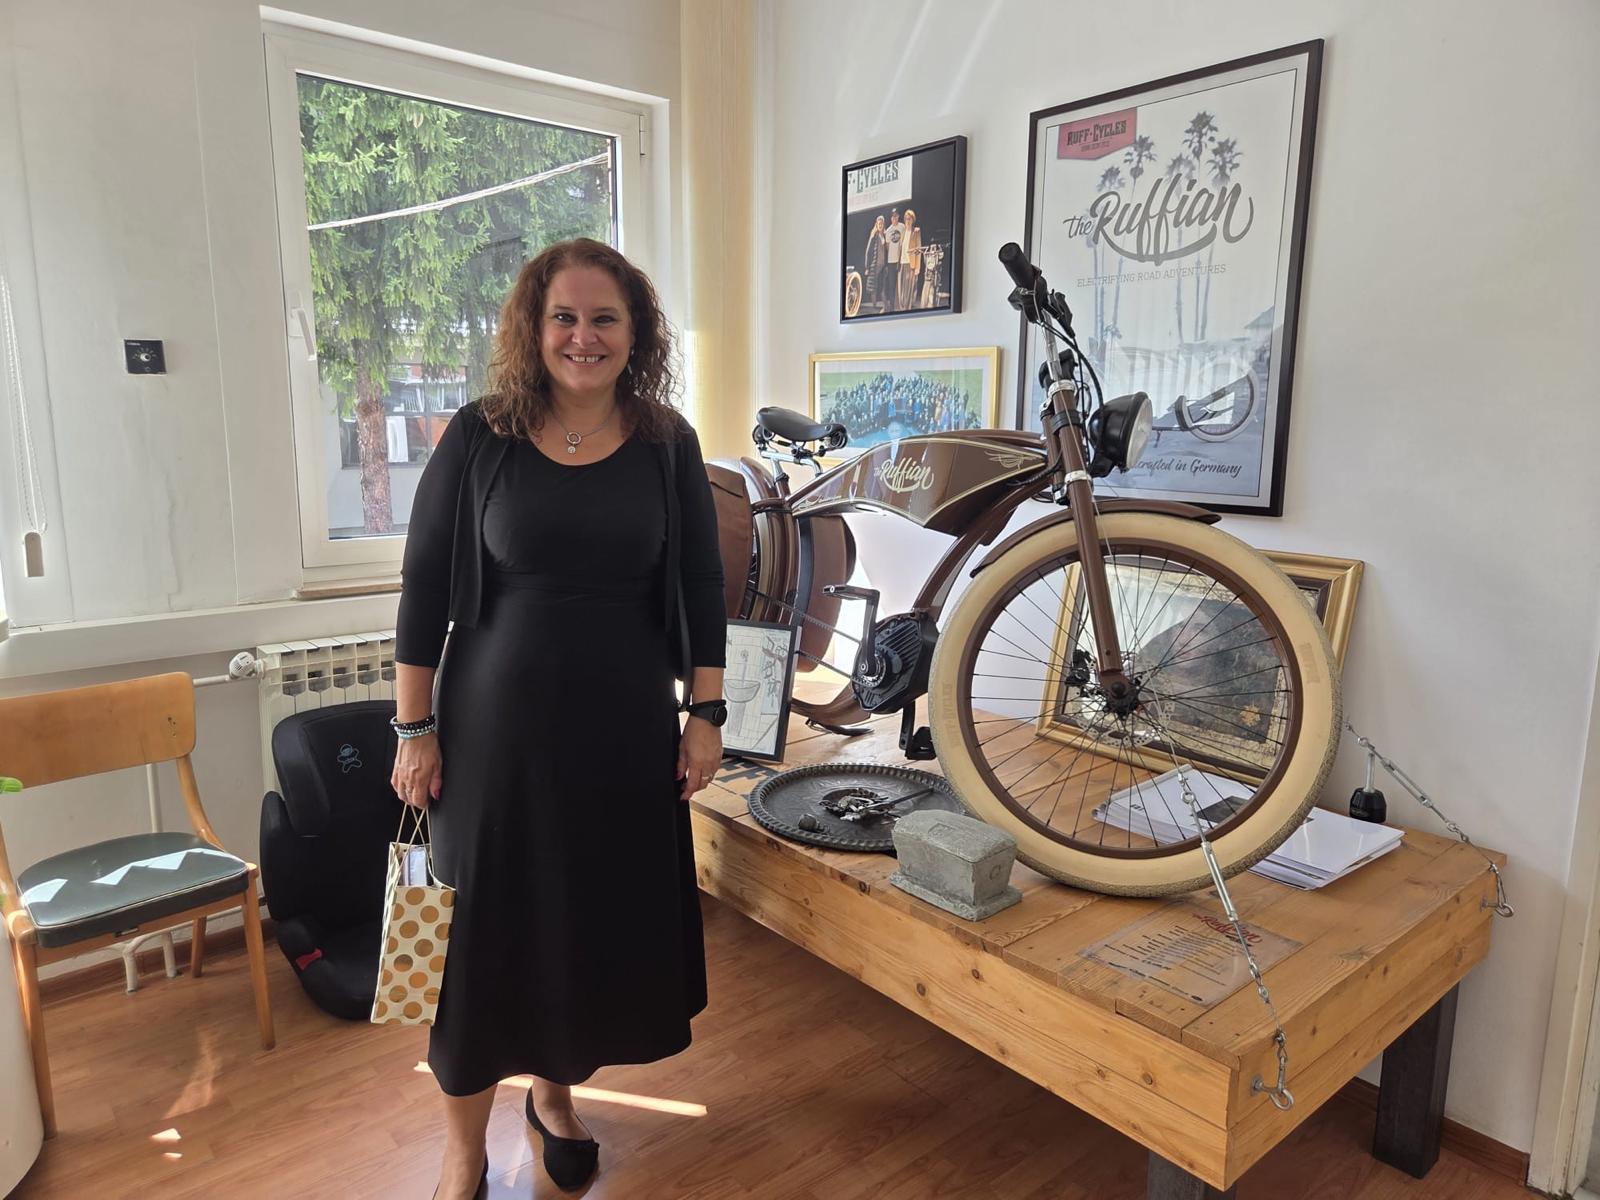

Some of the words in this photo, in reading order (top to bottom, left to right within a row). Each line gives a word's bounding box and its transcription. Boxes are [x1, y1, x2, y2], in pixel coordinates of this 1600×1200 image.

[1063, 215, 1094, 239] the
[1090, 173, 1254, 266] Ruffian
[1076, 273, 1135, 288] ELECTRIFYING
[1137, 269, 1162, 281] ROAD
[1162, 264, 1227, 279] ADVENTURES
[880, 457, 935, 493] Ruffian
[1174, 460, 1187, 471] in
[1189, 458, 1243, 479] Germany
